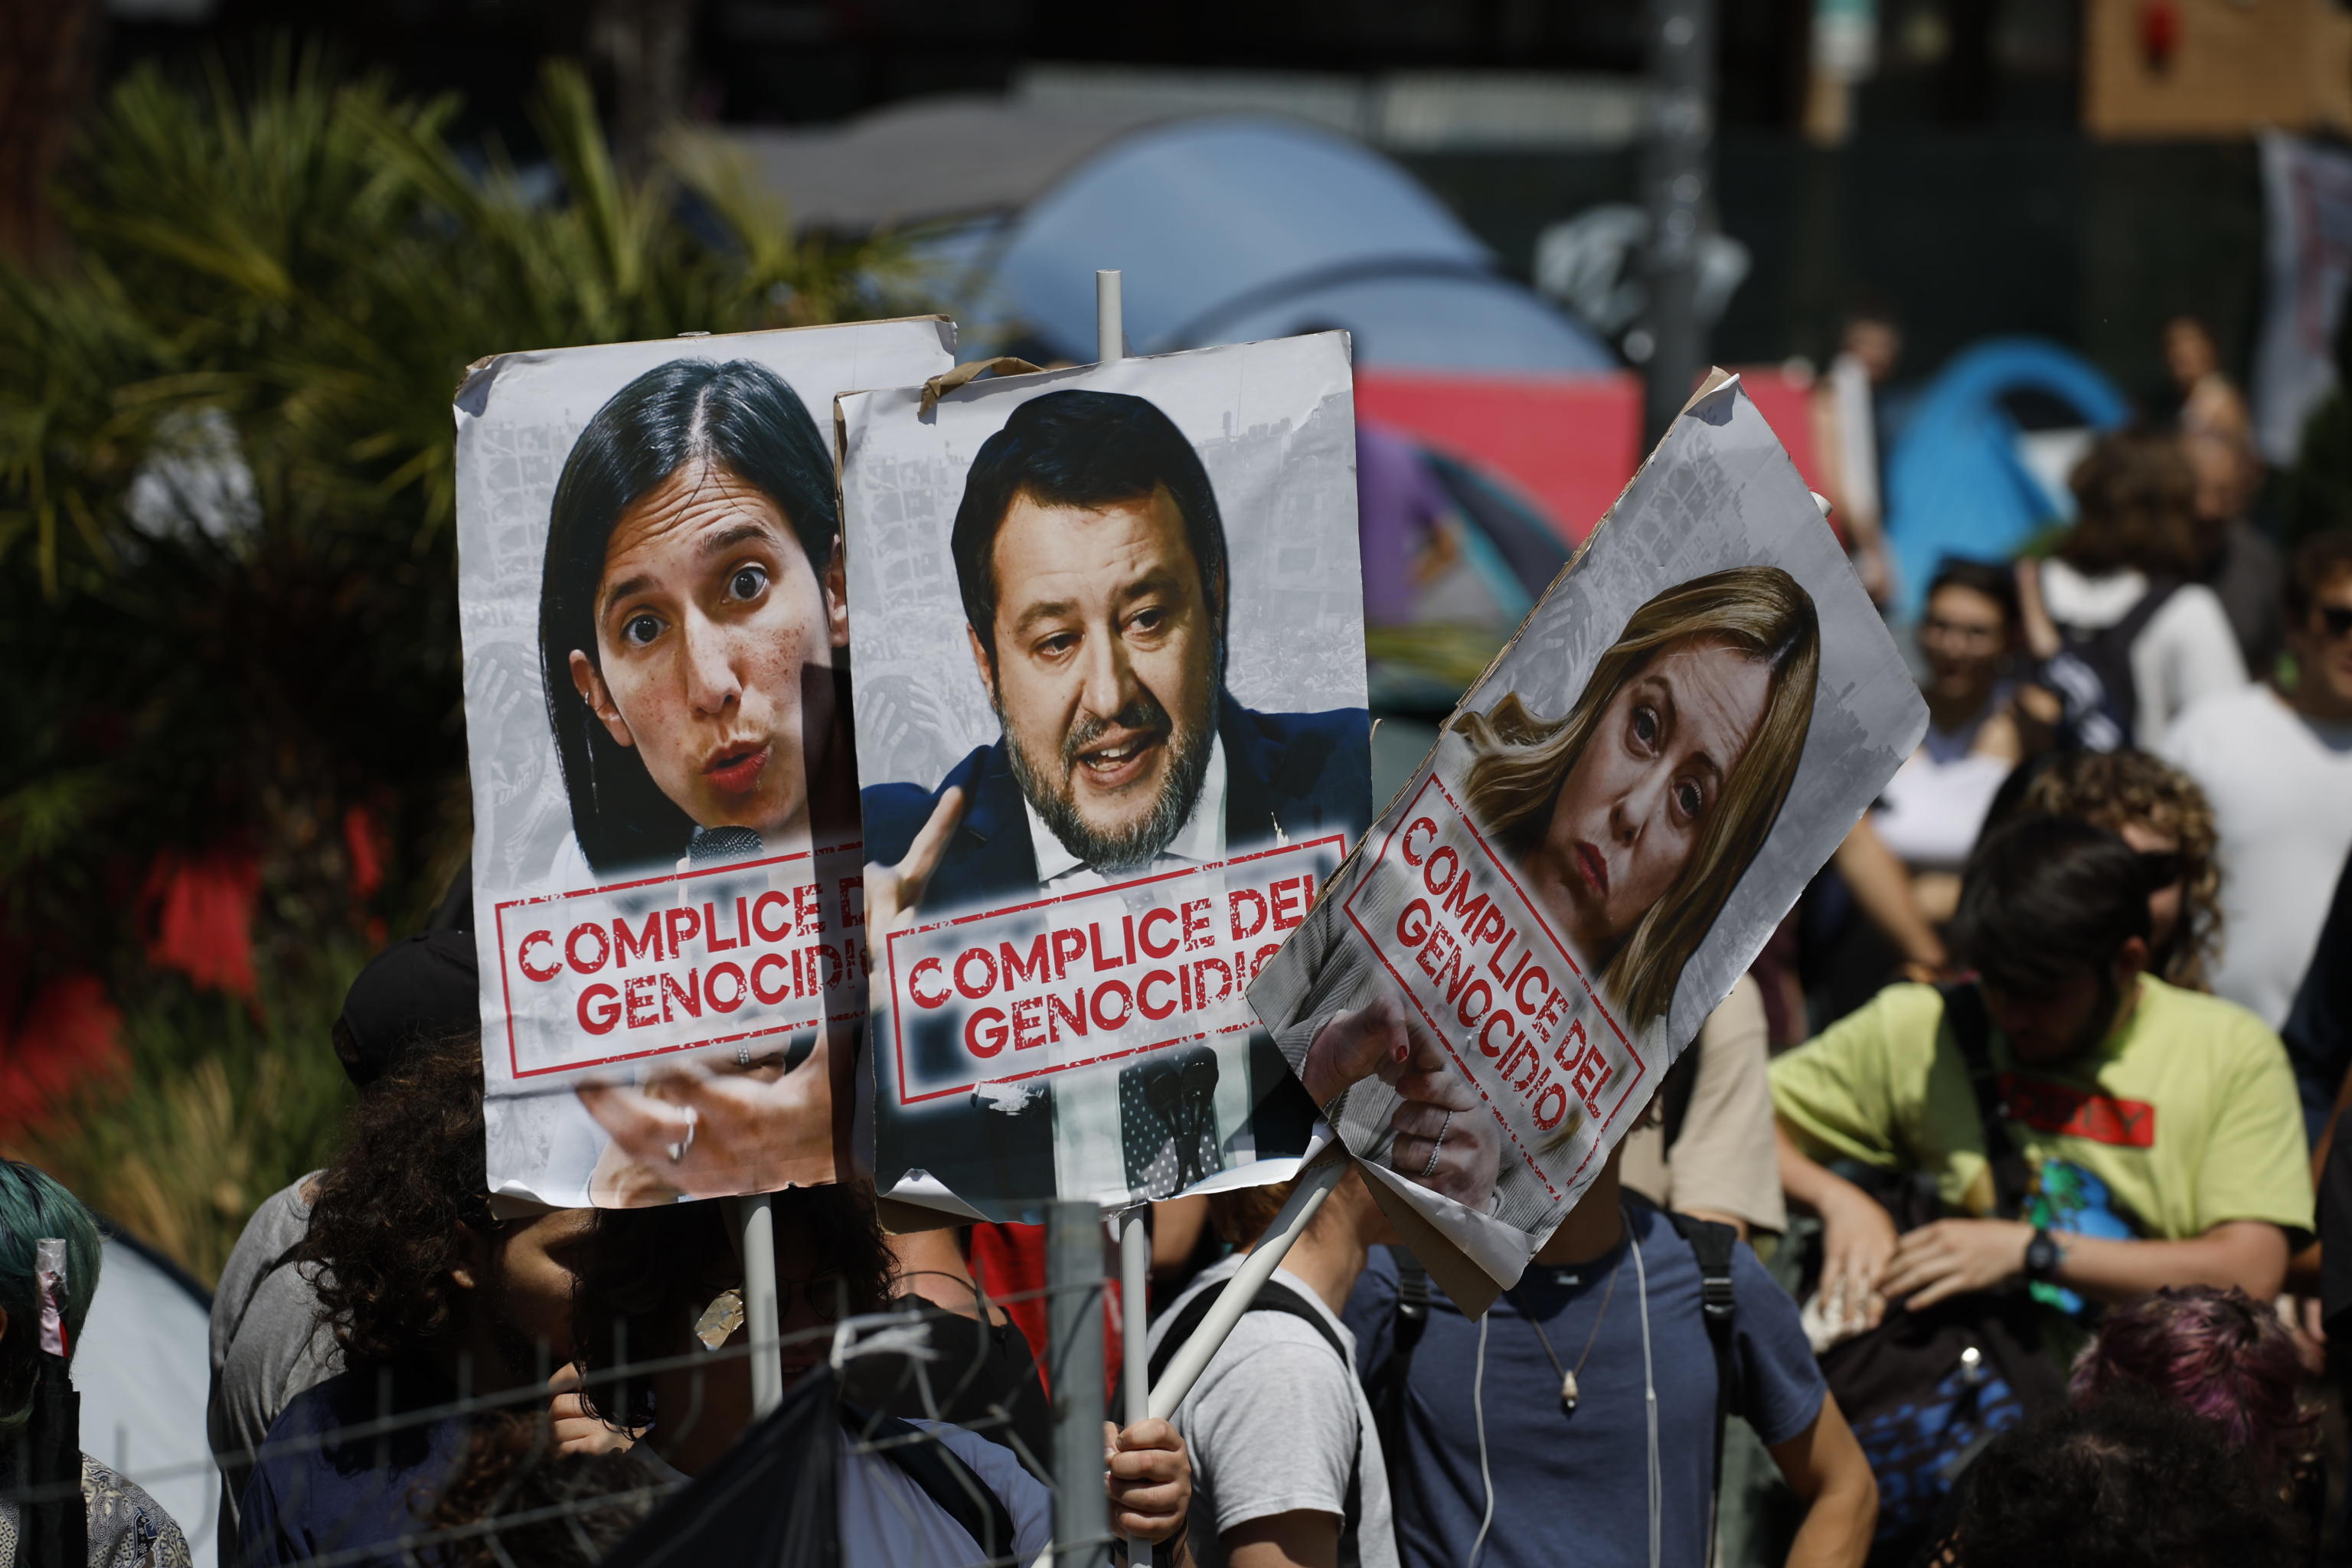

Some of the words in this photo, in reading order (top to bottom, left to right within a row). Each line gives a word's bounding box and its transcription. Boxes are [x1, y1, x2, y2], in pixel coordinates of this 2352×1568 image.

[519, 884, 825, 982] COMPLICE
[577, 939, 870, 1035] GENOCIDI
[910, 899, 1215, 1009] COMPLICE
[1403, 818, 1568, 1043] COMPLICE
[1554, 1019, 1612, 1118] DEL
[1397, 899, 1566, 1130] GENOCIDIO
